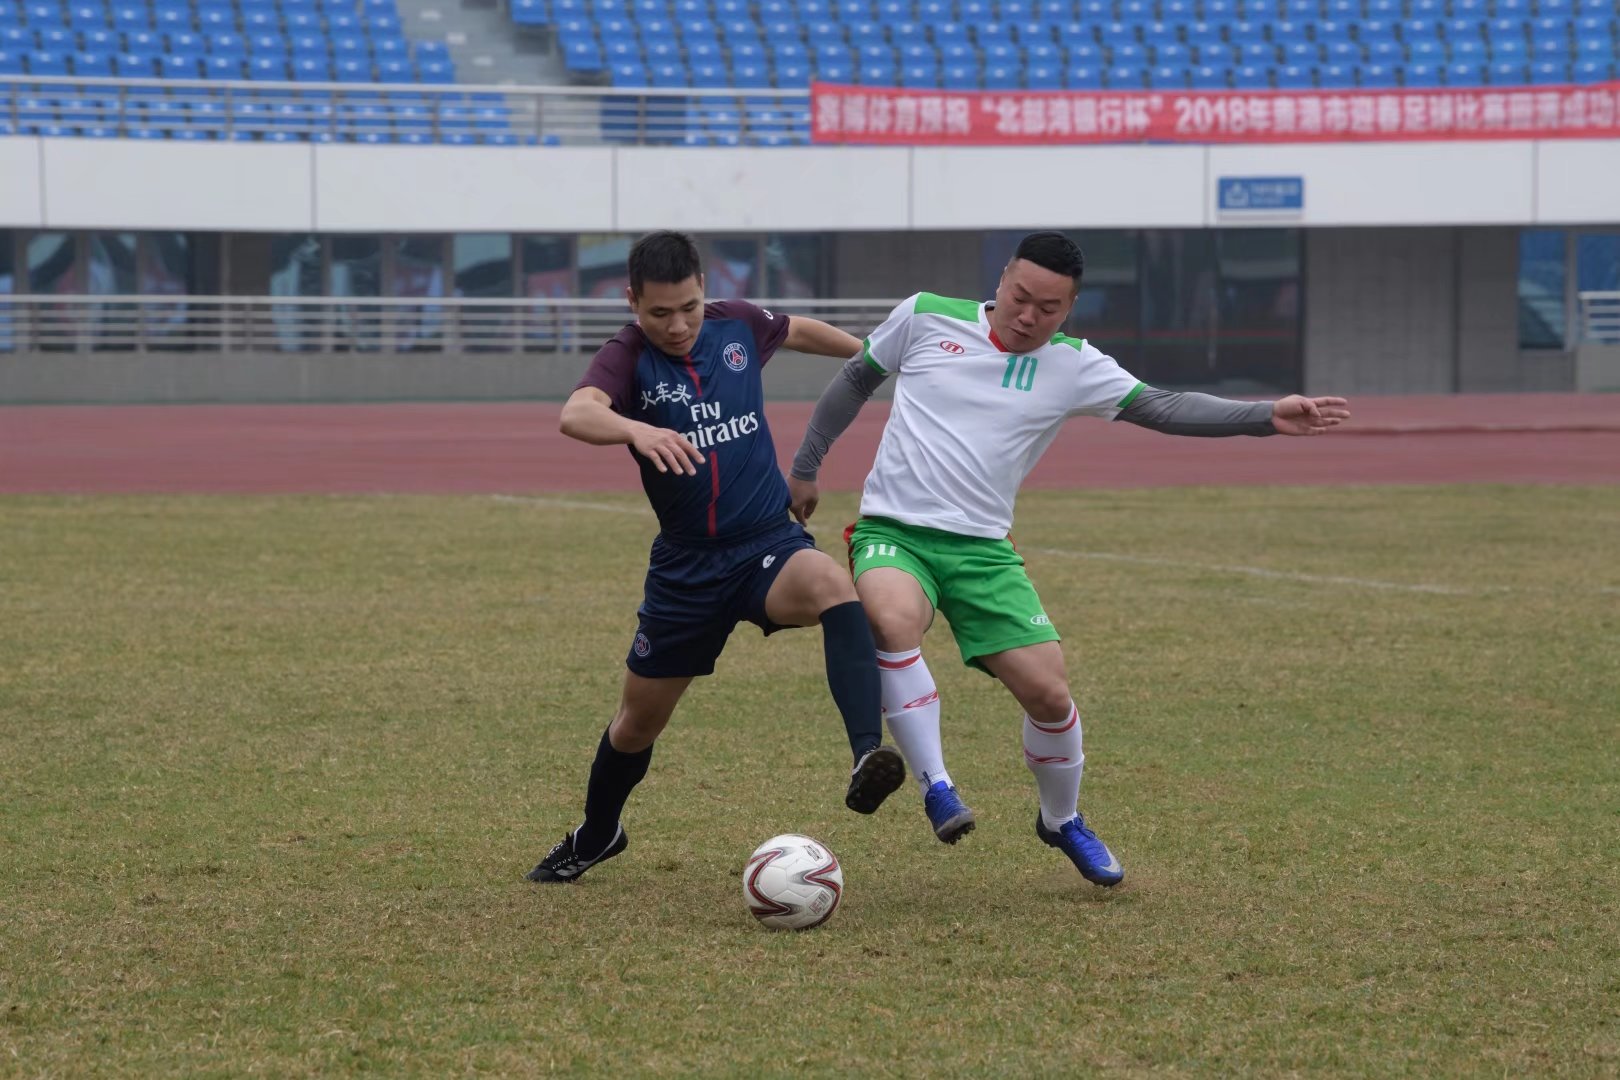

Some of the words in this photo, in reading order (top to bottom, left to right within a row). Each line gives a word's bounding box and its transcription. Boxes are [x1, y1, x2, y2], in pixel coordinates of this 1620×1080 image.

[1174, 90, 1620, 135] 2018年贵港市迎春足球比赛圆满成功
[1001, 355, 1039, 392] 10
[641, 381, 692, 410] 火车头
[690, 401, 721, 422] Fly
[679, 411, 759, 449] mirates
